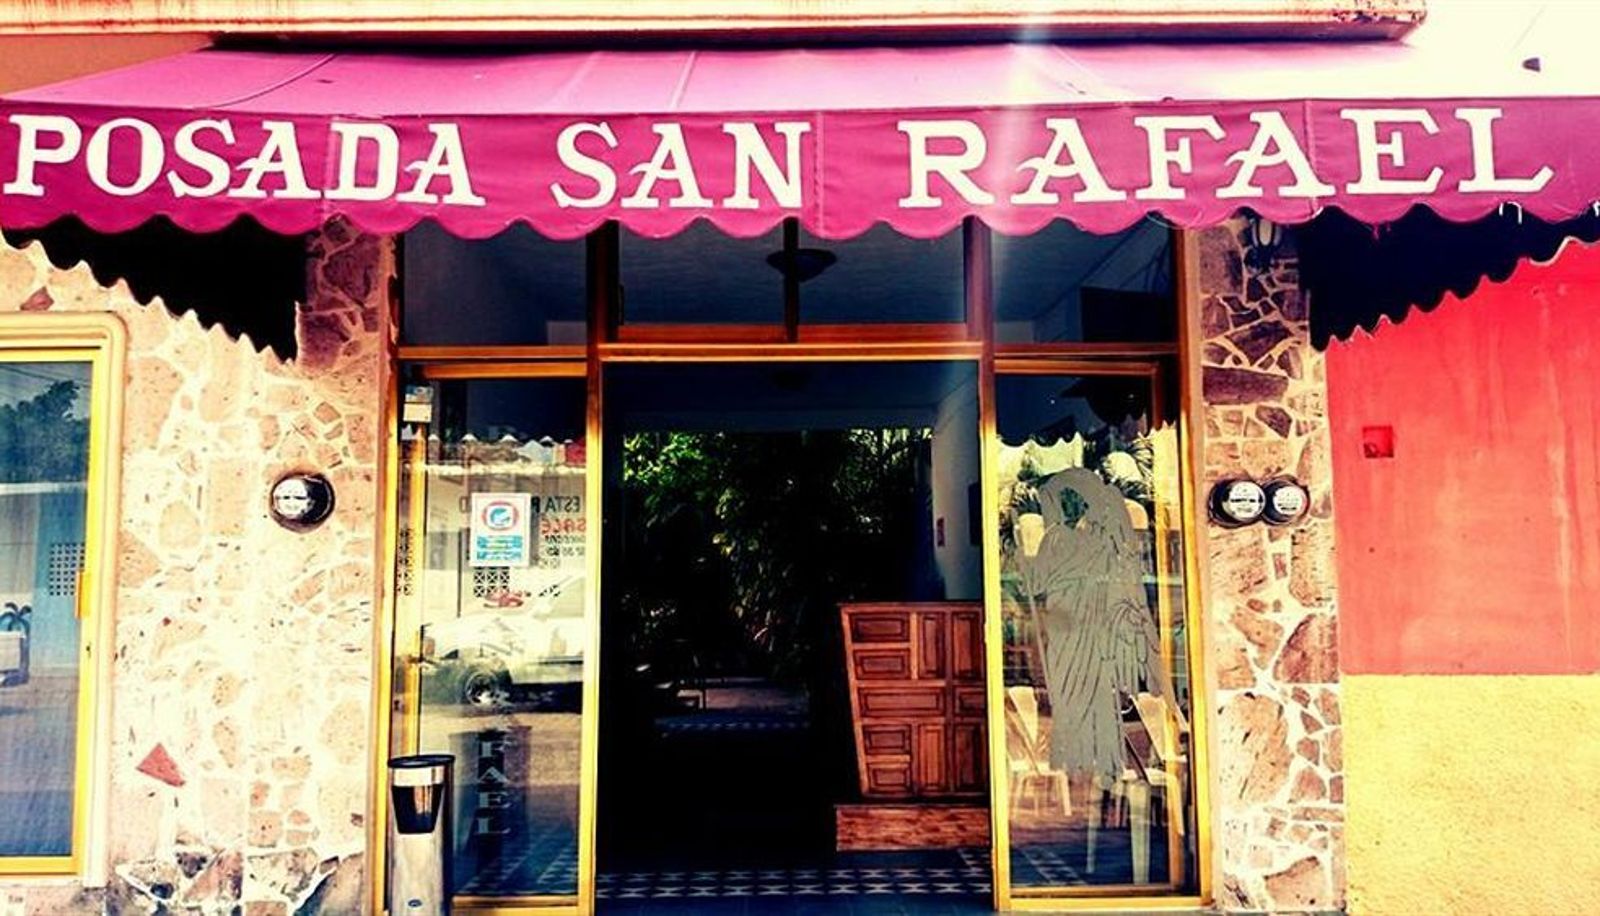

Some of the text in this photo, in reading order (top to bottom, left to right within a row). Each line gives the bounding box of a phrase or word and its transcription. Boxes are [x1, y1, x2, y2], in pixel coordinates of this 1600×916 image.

[3, 107, 1554, 210] POSADA SAN RAFAEL
